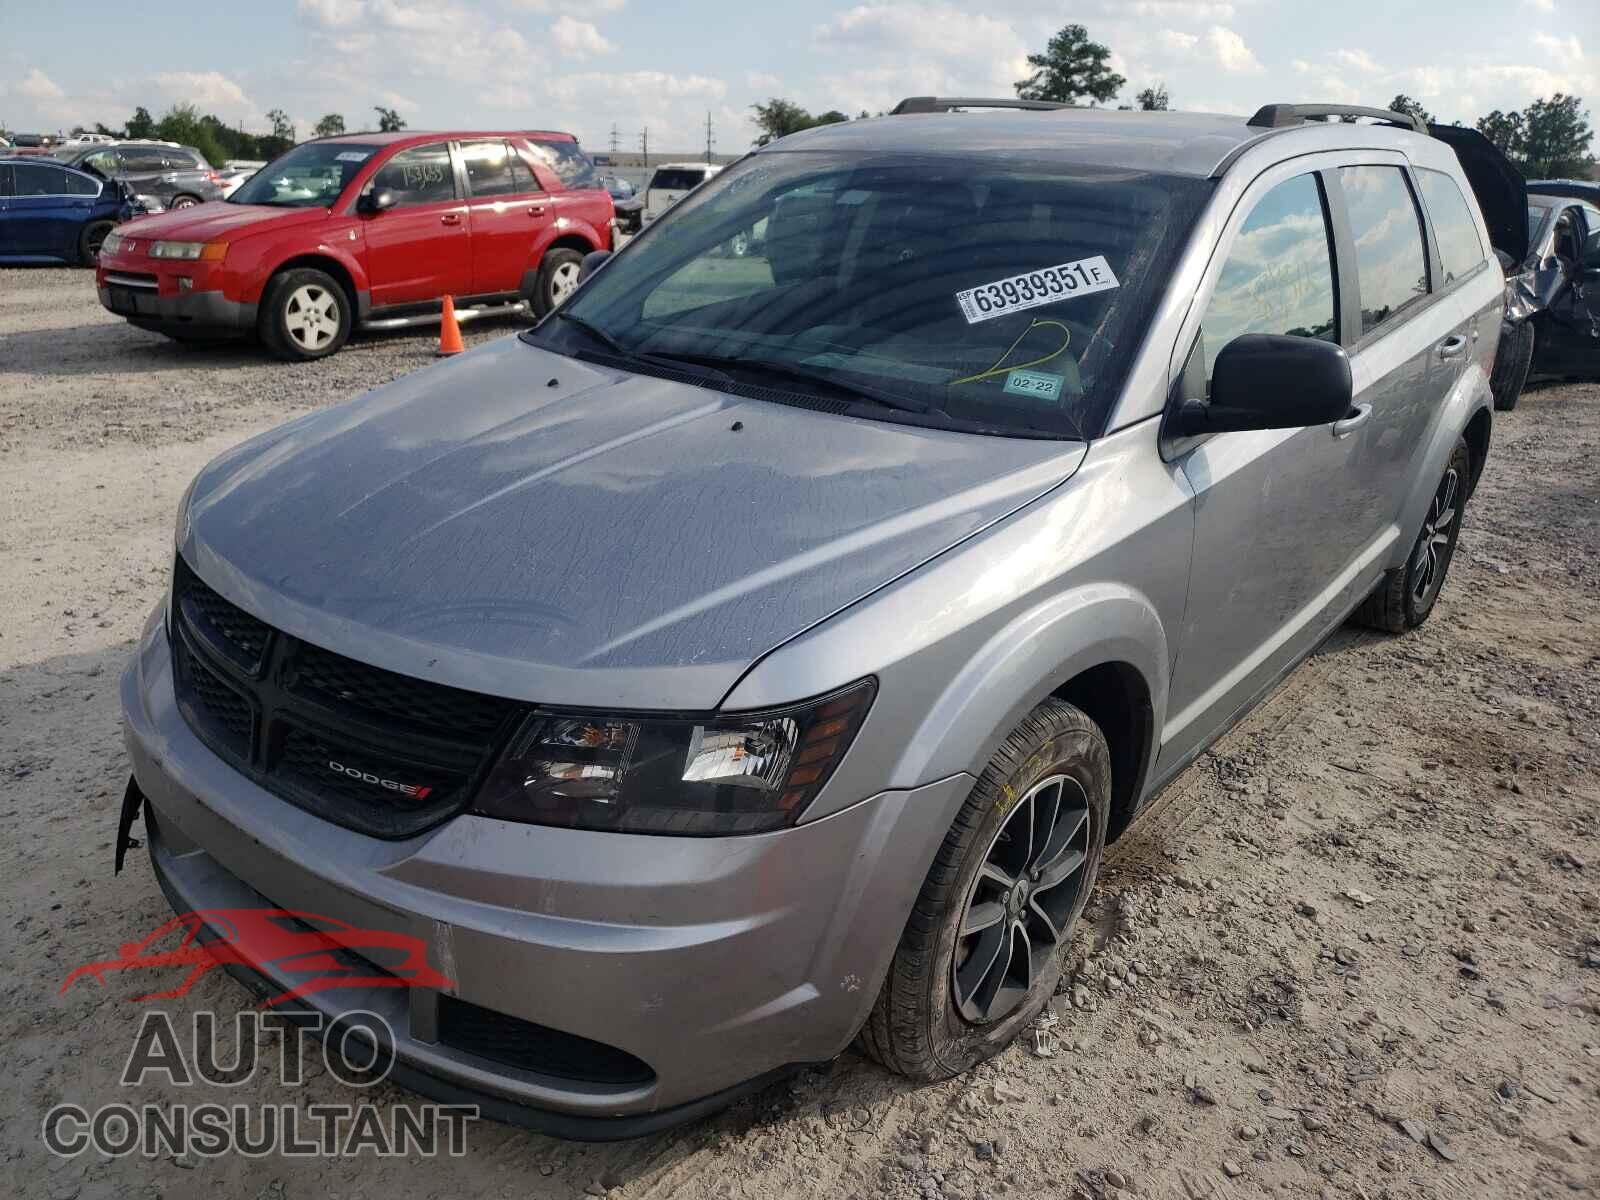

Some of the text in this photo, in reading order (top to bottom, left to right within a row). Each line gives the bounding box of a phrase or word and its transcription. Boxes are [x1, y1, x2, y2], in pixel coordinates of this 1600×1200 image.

[974, 263, 1091, 313] 63939351
[1090, 267, 1101, 282] F
[1013, 377, 1053, 392] 02-22
[329, 760, 417, 796] DODGE
